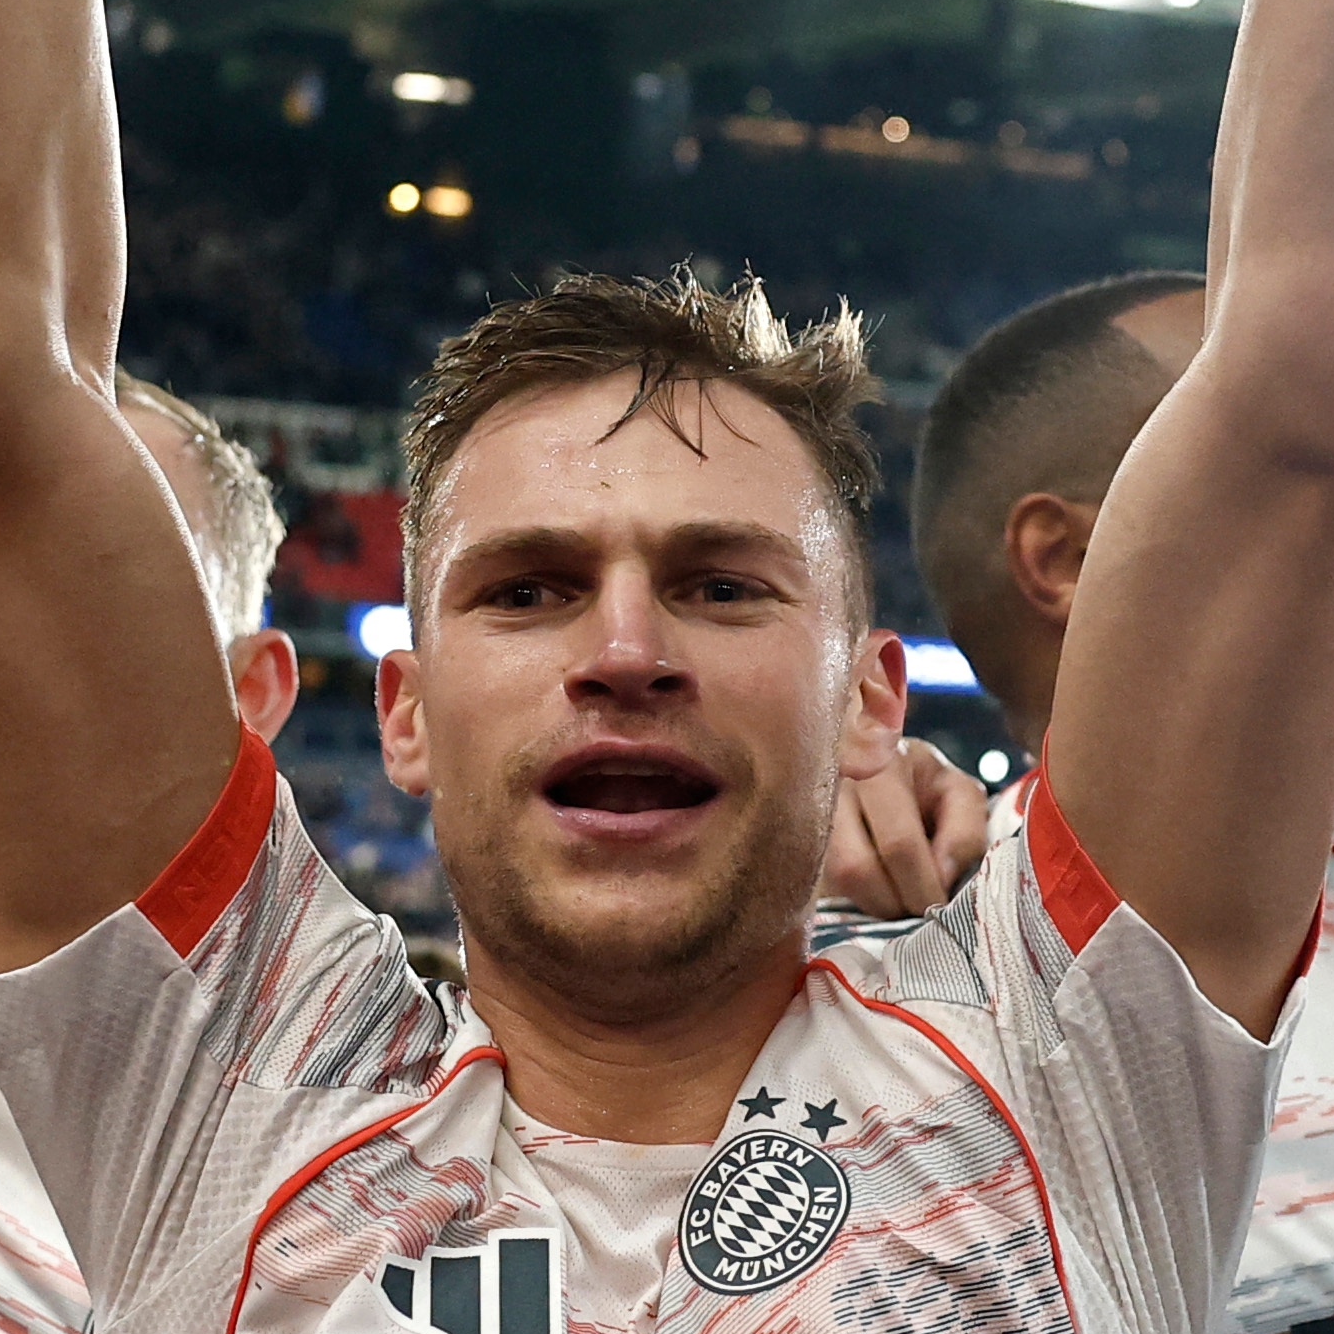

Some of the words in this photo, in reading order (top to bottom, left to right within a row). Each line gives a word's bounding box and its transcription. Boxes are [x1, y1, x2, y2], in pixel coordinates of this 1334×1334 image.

[700, 1139, 814, 1200] BAYERN
[690, 1208, 711, 1248] FC
[712, 1186, 838, 1282] MÜNCHEN
